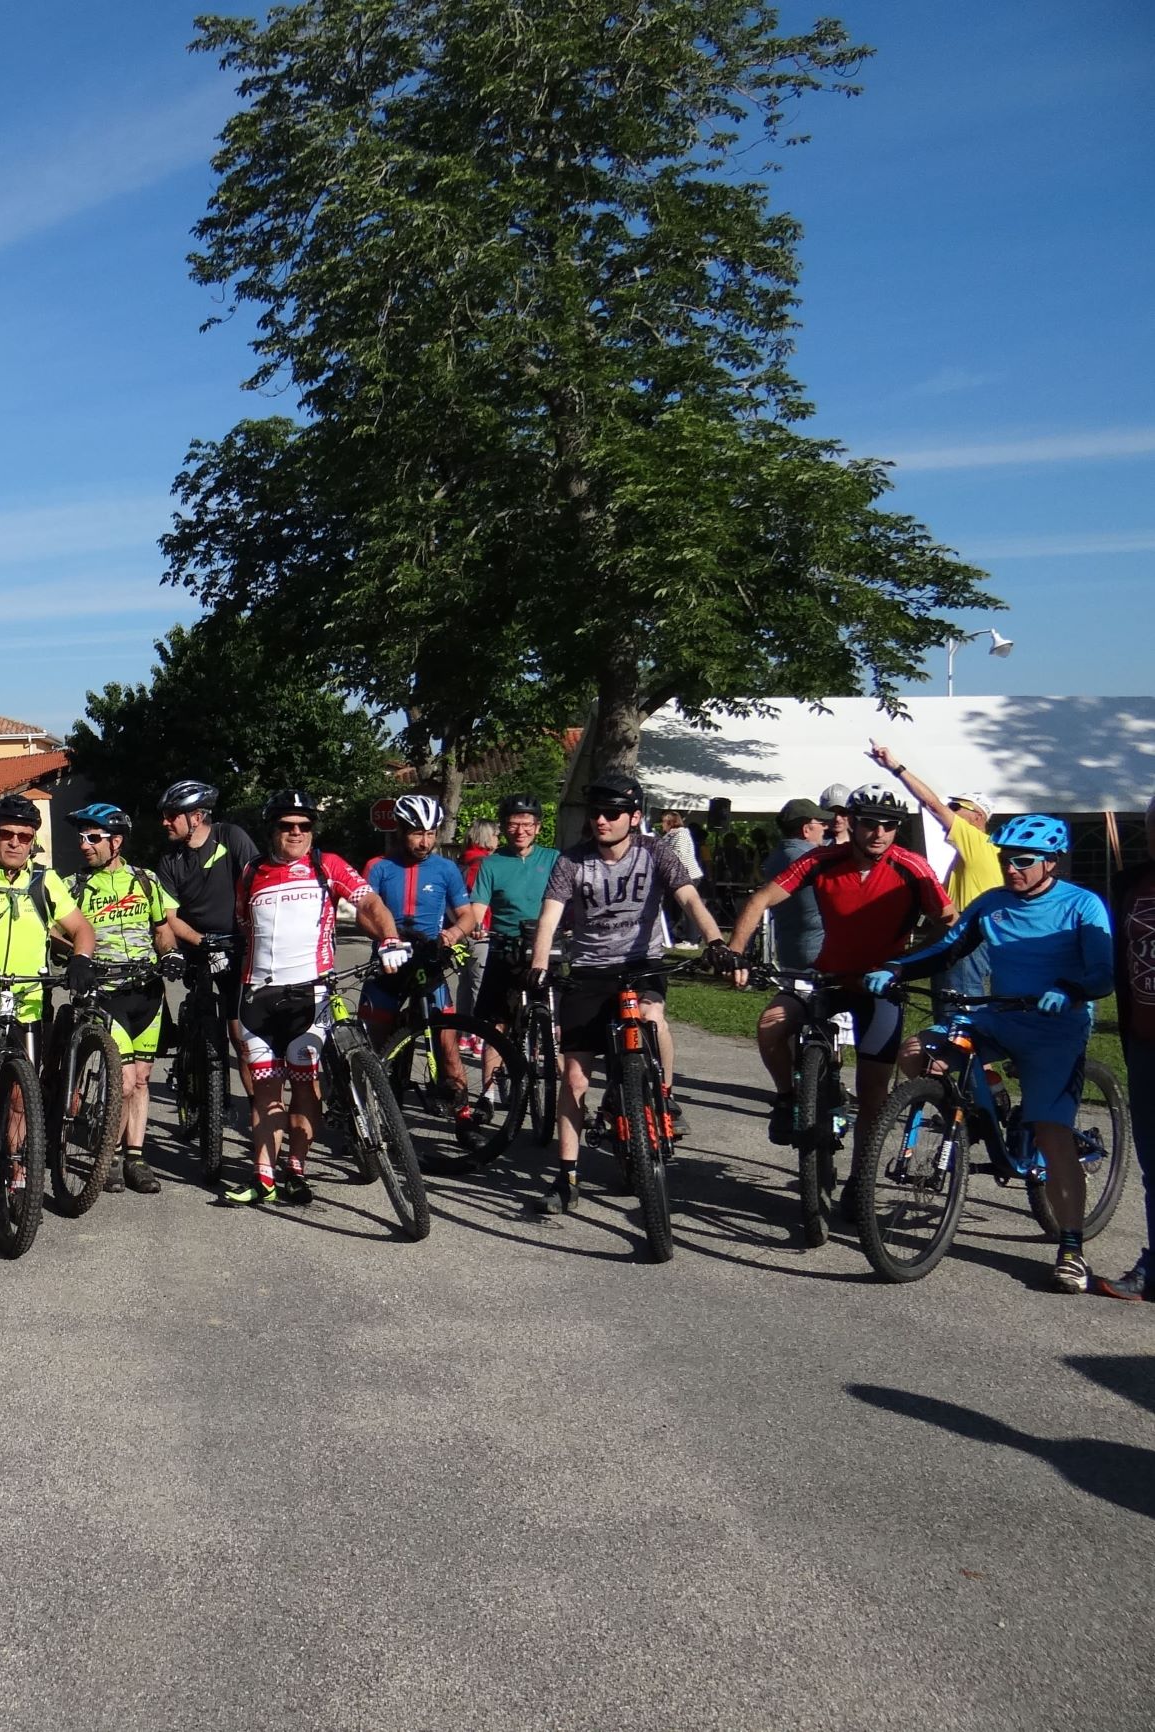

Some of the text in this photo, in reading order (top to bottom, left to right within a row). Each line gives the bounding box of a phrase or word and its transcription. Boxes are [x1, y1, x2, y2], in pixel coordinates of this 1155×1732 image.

[293, 793, 303, 807] 1
[374, 811, 395, 821] STO
[281, 892, 319, 902] AUCH
[581, 872, 648, 909] RIDE
[90, 895, 117, 913] TEAM
